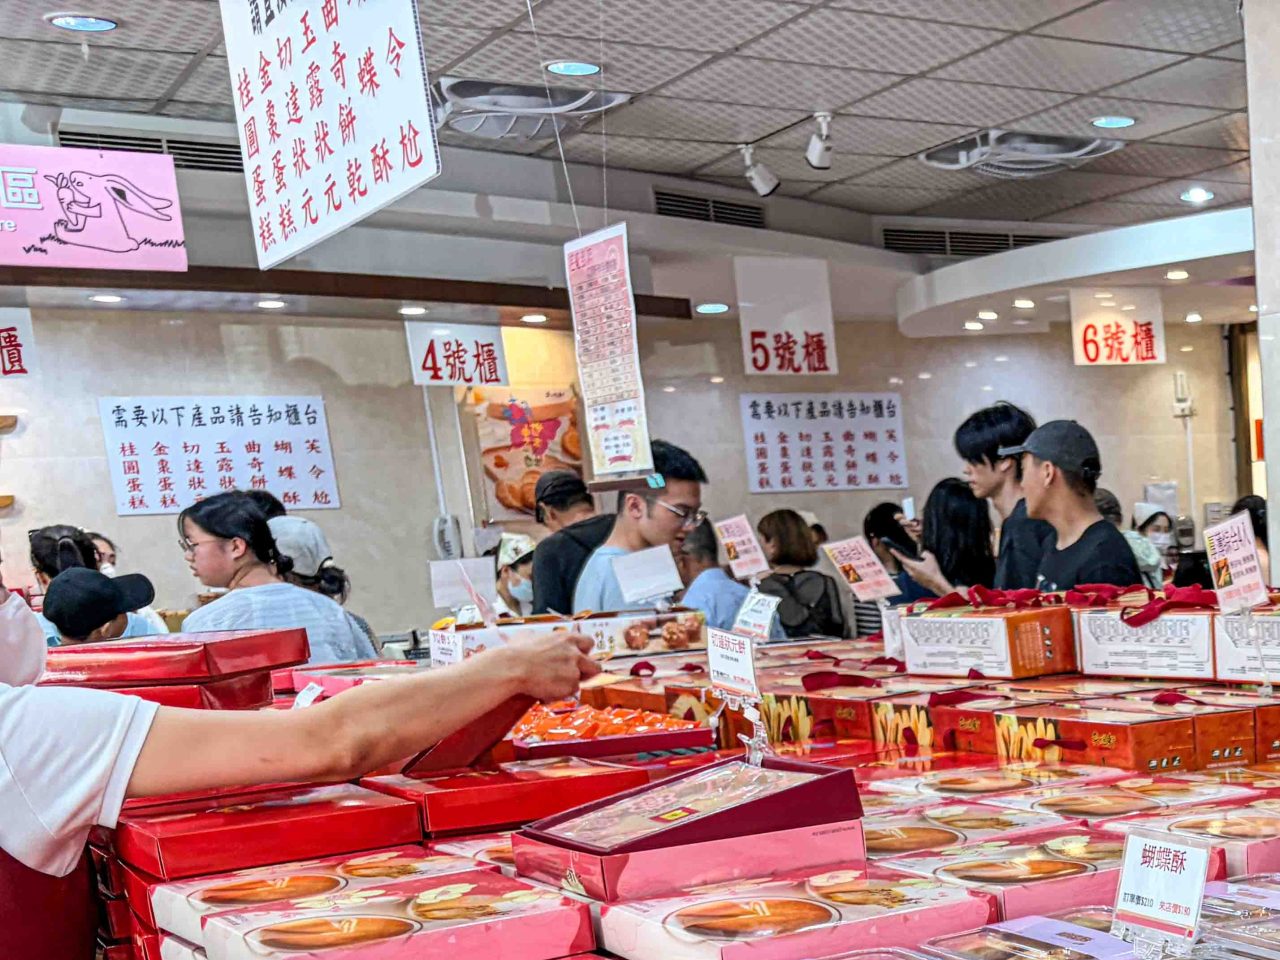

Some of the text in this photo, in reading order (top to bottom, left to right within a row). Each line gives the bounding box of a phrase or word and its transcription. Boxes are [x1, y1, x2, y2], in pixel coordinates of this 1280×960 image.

[236, 67, 276, 253] 桂圓蛋糕
[257, 50, 298, 242] 金棗蛋糕
[276, 37, 319, 228] 切達狀元
[300, 9, 343, 216] 玉露狀元
[321, 0, 368, 205] 曲奇餅乾
[421, 337, 501, 384] 4號櫃
[750, 330, 829, 373] 5號櫃
[1082, 320, 1157, 363] 6號櫃
[111, 402, 318, 429] 需要以下產品請告知櫃台
[1141, 843, 1187, 874] 蝴蝶酥
